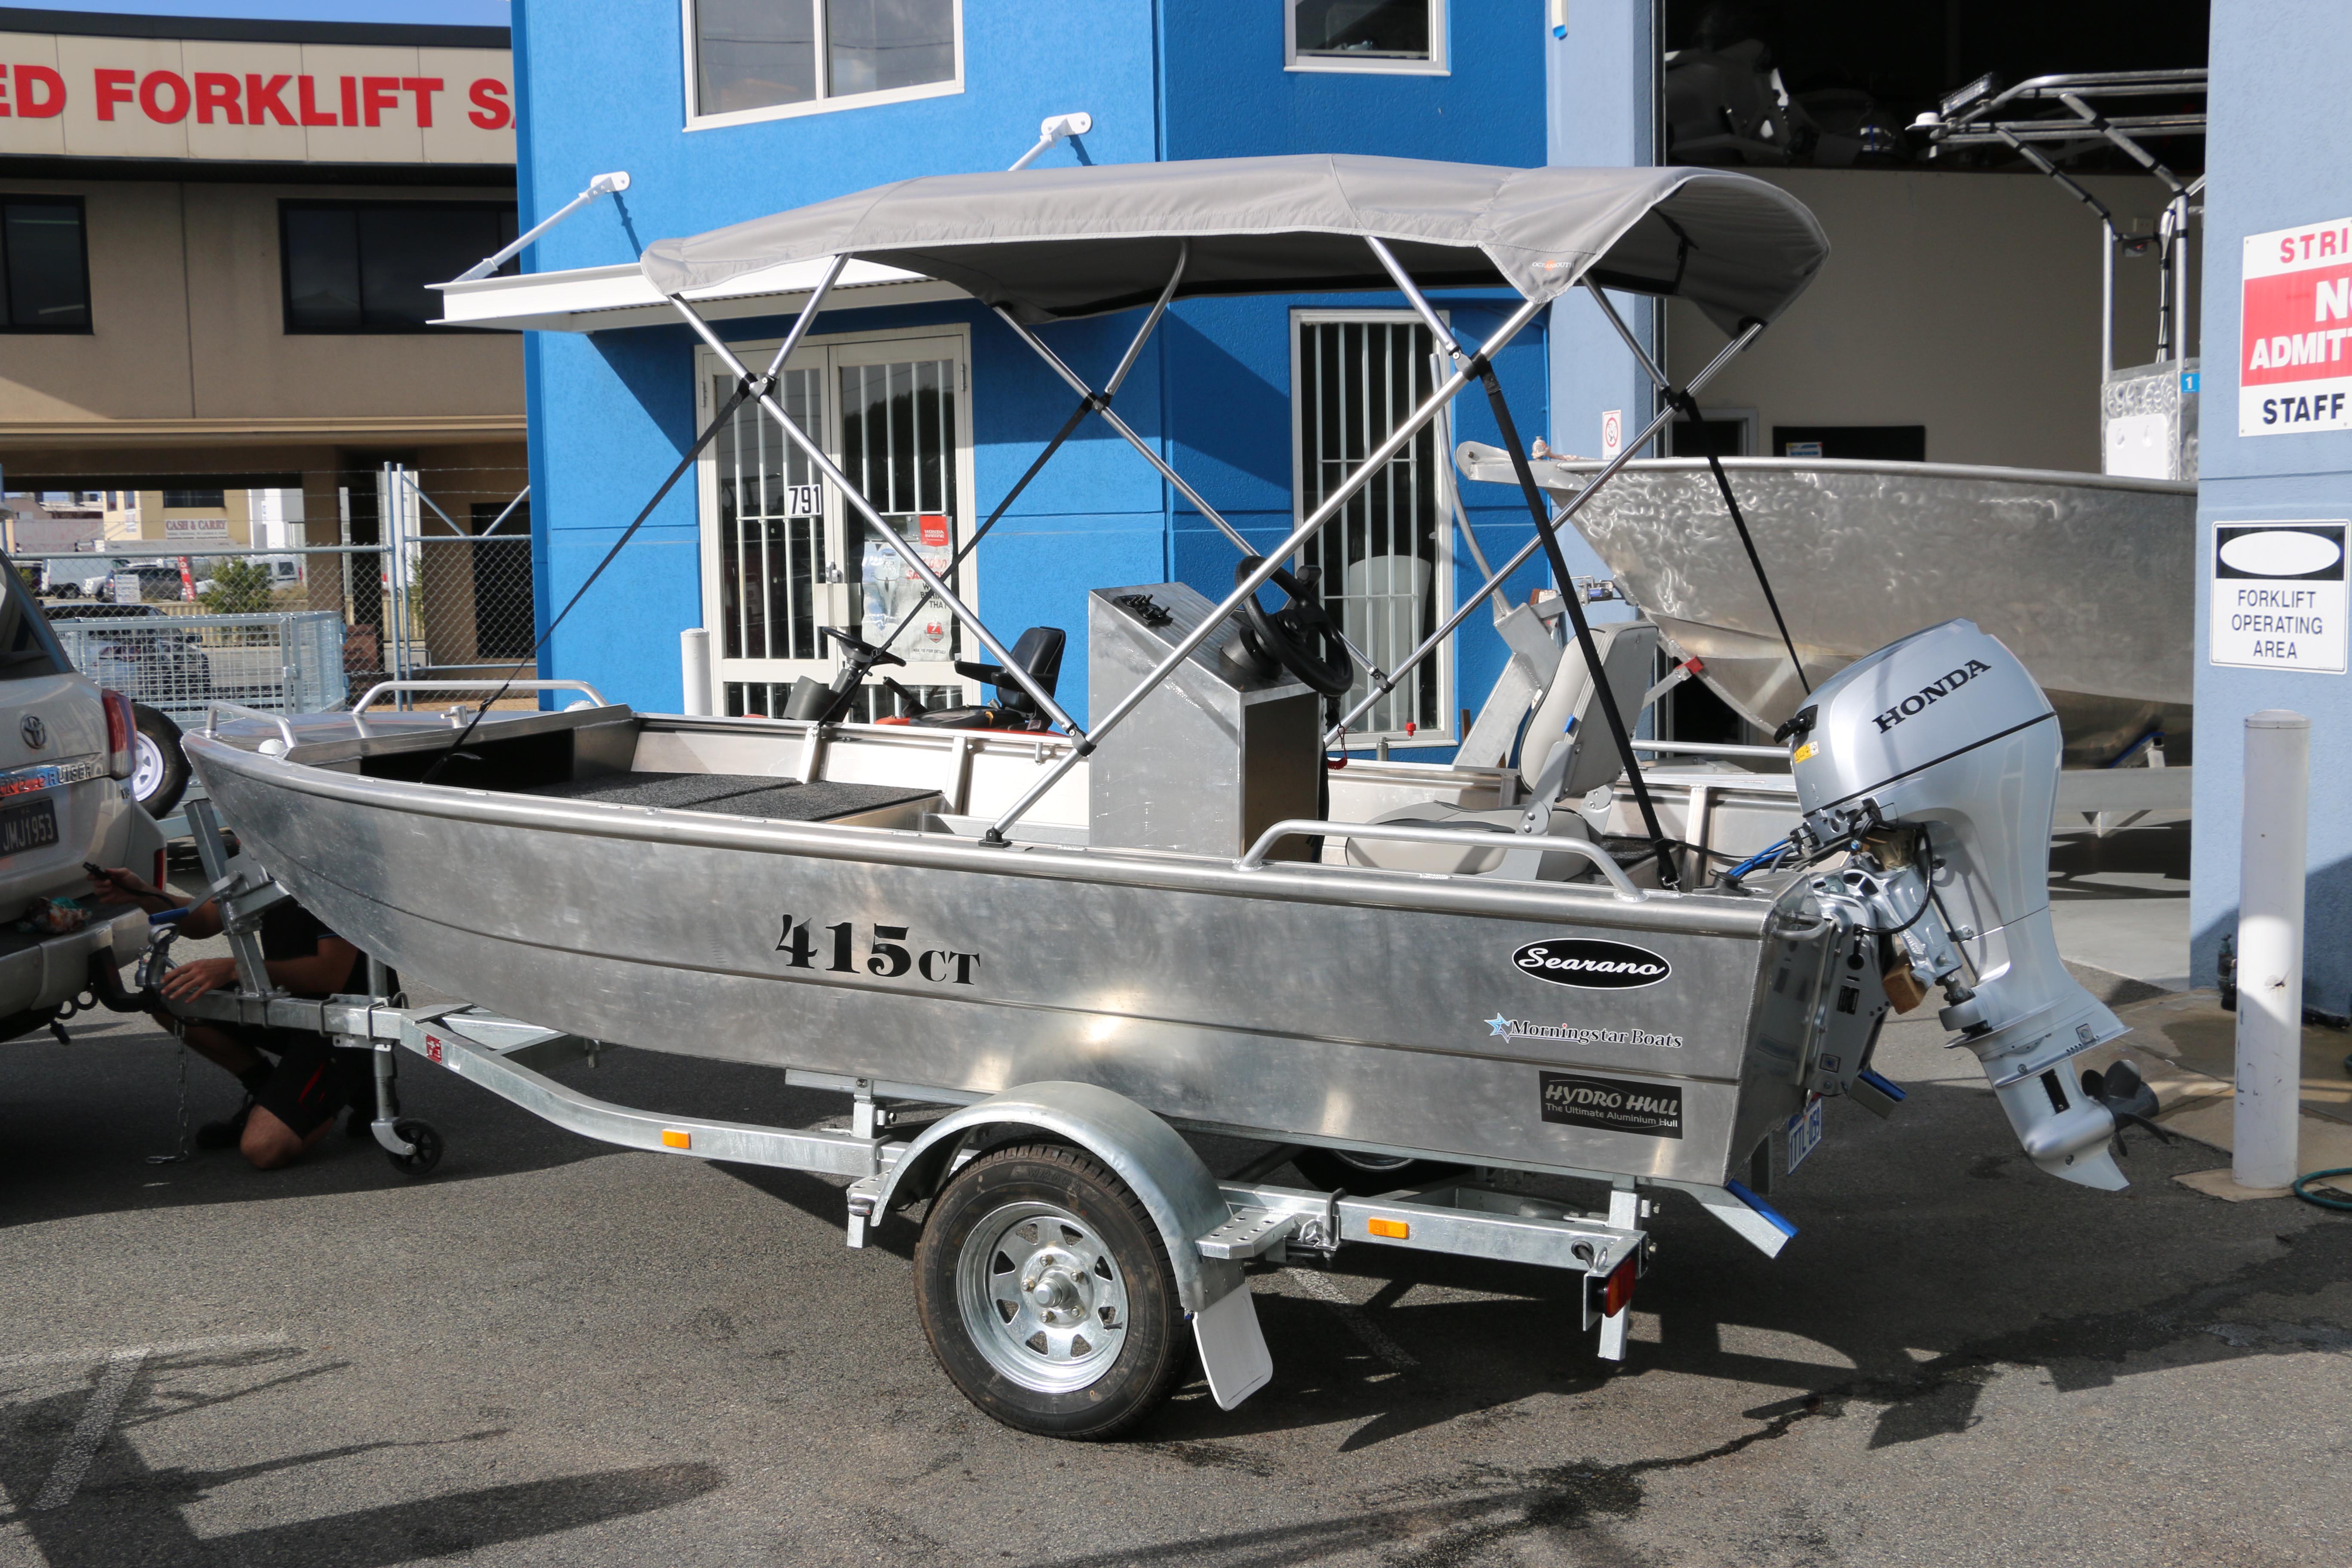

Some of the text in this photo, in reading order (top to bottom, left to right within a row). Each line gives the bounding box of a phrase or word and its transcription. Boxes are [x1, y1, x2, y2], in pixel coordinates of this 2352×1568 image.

[95, 69, 444, 128] FORKLIFT
[2315, 277, 2352, 322] N
[2263, 393, 2345, 425] STAFF
[788, 486, 819, 514] 791
[166, 520, 188, 530] CASH
[198, 520, 226, 530] CARRY
[2238, 590, 2316, 609] FORKLIFT
[2232, 614, 2323, 634] OPERATING
[2253, 640, 2298, 659] AREA
[1872, 658, 1991, 734] HONDA
[37, 763, 92, 787] CRUISER
[3, 813, 53, 851] JMJ1953
[1519, 948, 1665, 975] Searano
[1511, 1020, 1682, 1048] Morningstar Boats
[1546, 1084, 1678, 1116] HYDRO HULL
[1546, 1102, 1678, 1127] The Ultimate Aluminium Hull
